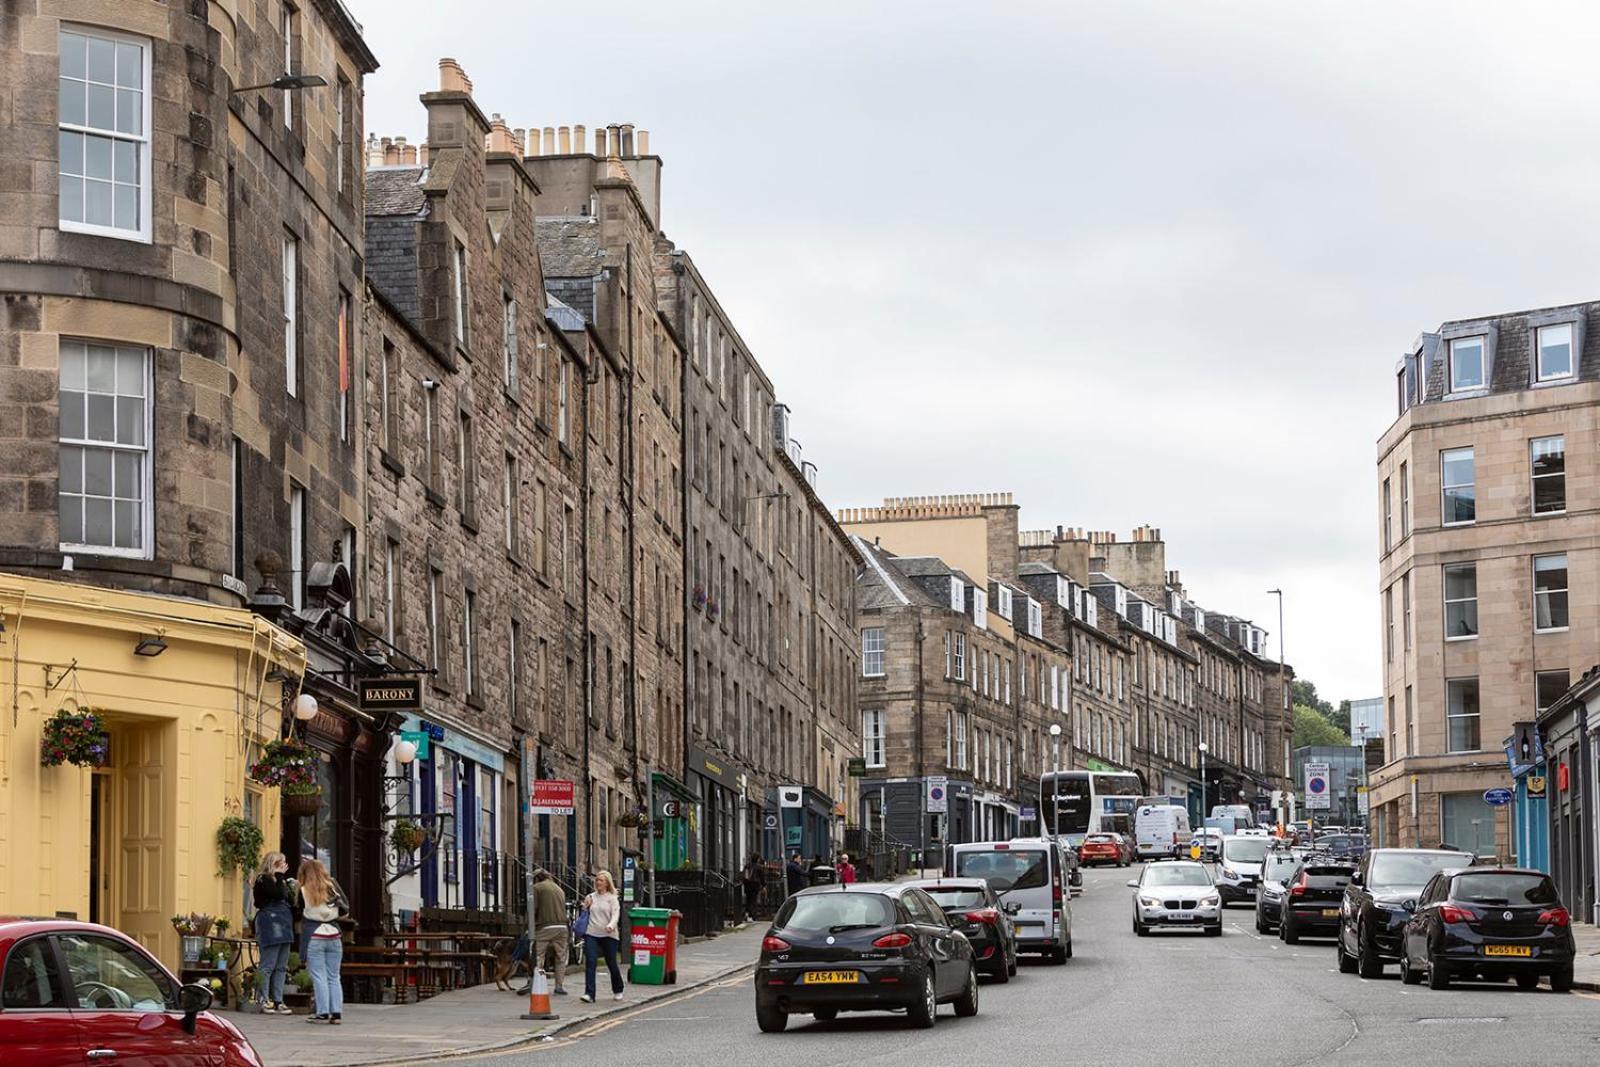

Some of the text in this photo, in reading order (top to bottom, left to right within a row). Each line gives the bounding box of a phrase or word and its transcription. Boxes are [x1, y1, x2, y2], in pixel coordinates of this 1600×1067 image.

[366, 689, 415, 700] BARONY
[626, 857, 633, 867] P
[807, 972, 832, 982] EA54
